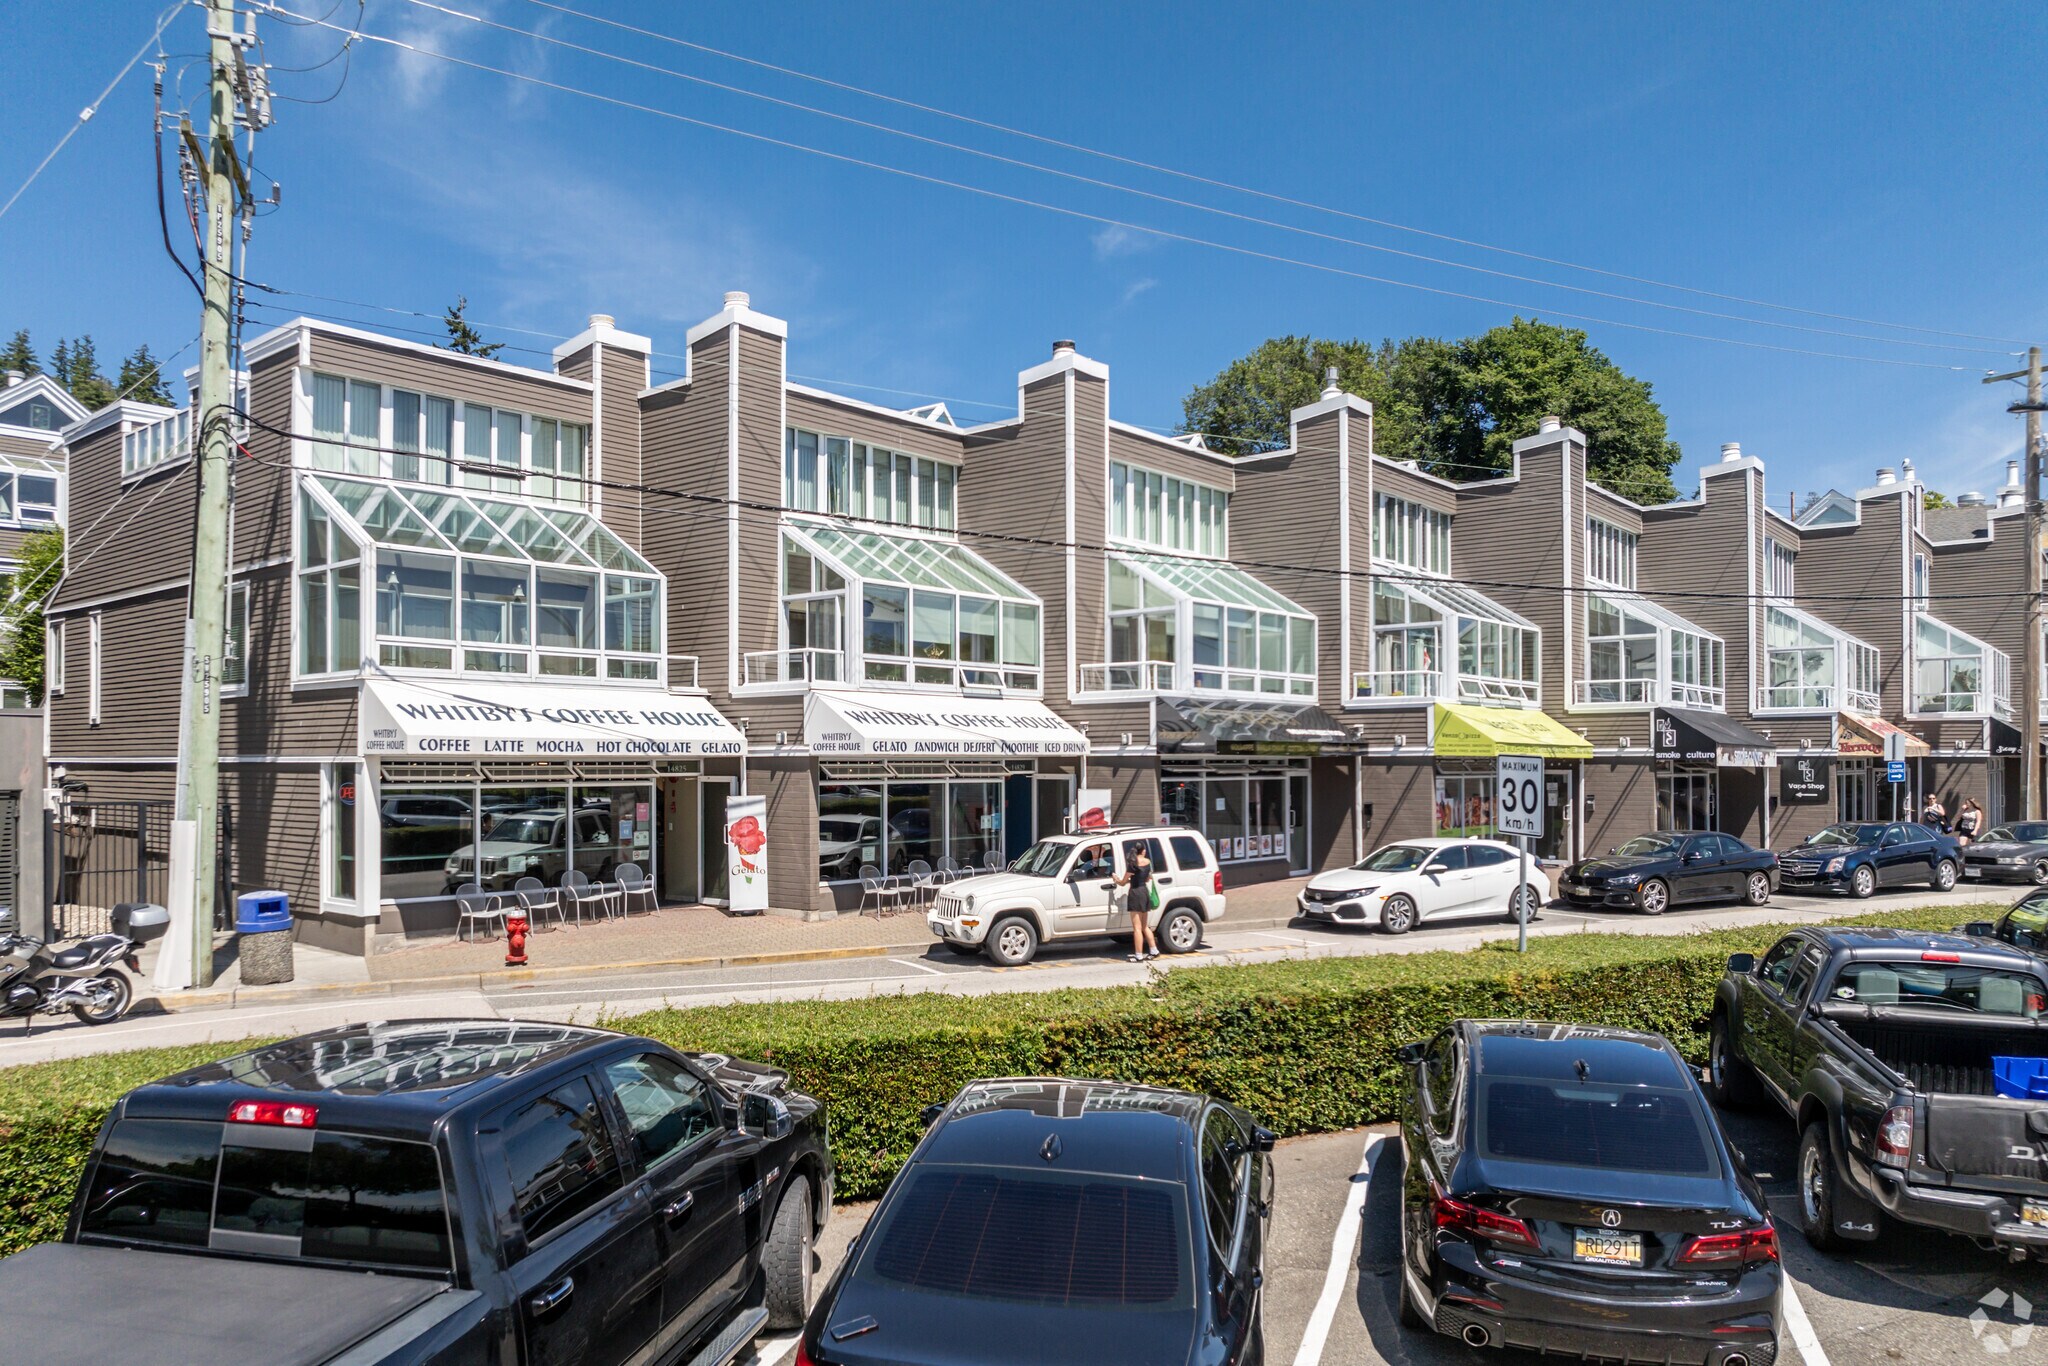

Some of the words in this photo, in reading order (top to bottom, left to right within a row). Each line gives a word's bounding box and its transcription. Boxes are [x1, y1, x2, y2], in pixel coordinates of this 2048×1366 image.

[396, 703, 533, 722] WHITBY'S
[541, 708, 640, 725] COFFEE
[640, 711, 726, 727] HOUSE
[844, 710, 940, 727] WHITBY'S
[940, 714, 1012, 729] COFFEE
[1006, 716, 1070, 730] HOUSE
[373, 729, 398, 739] WHITBY'S
[821, 732, 852, 741] WHITBY'S
[366, 740, 386, 750] COFFEE
[386, 740, 405, 750] HOUSE
[418, 738, 471, 752] COFFEE
[484, 739, 525, 752] LATTE
[536, 740, 584, 752] MOCHA
[596, 741, 621, 753] HOT
[625, 741, 691, 753] CHOCOLATE
[701, 742, 741, 754] GELATO
[813, 742, 837, 751] COFFEE
[838, 742, 861, 751] HOUSE
[872, 741, 908, 752] GELATO
[914, 741, 959, 753] SANDWICH
[963, 741, 996, 753] DESSERT
[1000, 742, 1039, 753] SMOOTHIE
[1044, 742, 1061, 753] ICED
[1063, 743, 1087, 753] DRINK
[1655, 751, 1681, 759] smoke
[1686, 751, 1715, 759] culture
[667, 764, 687, 773] 14825
[1502, 761, 1539, 772] MAXIMUM
[340, 786, 355, 799] OPE
[1502, 777, 1538, 815] 30
[1505, 815, 1534, 831] km/h
[731, 864, 766, 876] Gelato
[1710, 1220, 1742, 1229] TLX
[1840, 1221, 1875, 1233] 4x4
[1585, 1237, 1640, 1257] RD291T
